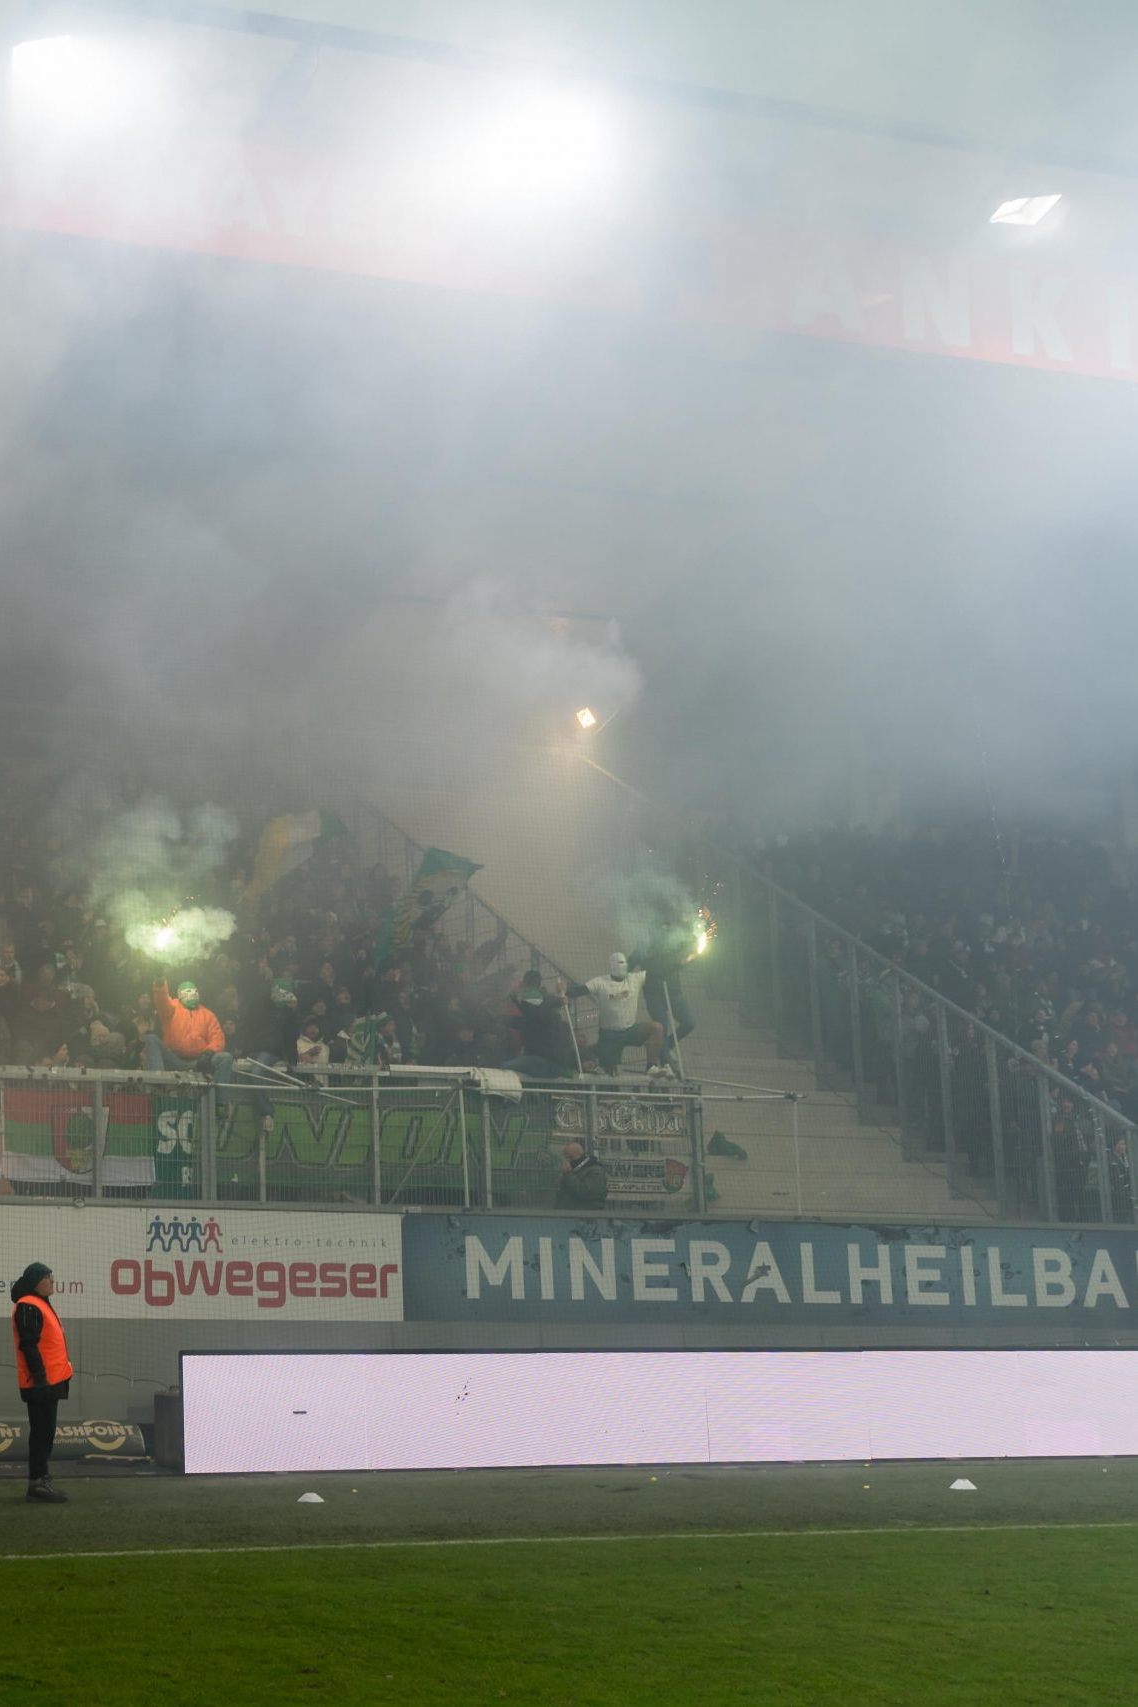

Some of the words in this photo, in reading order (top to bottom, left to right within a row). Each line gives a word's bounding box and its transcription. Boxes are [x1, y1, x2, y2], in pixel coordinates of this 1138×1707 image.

[231, 1235, 388, 1249] elektro-technik
[111, 1259, 398, 1308] obwegeser
[465, 1235, 1138, 1309] MINERALHEILBA
[55, 1425, 134, 1437] ASHPOINT
